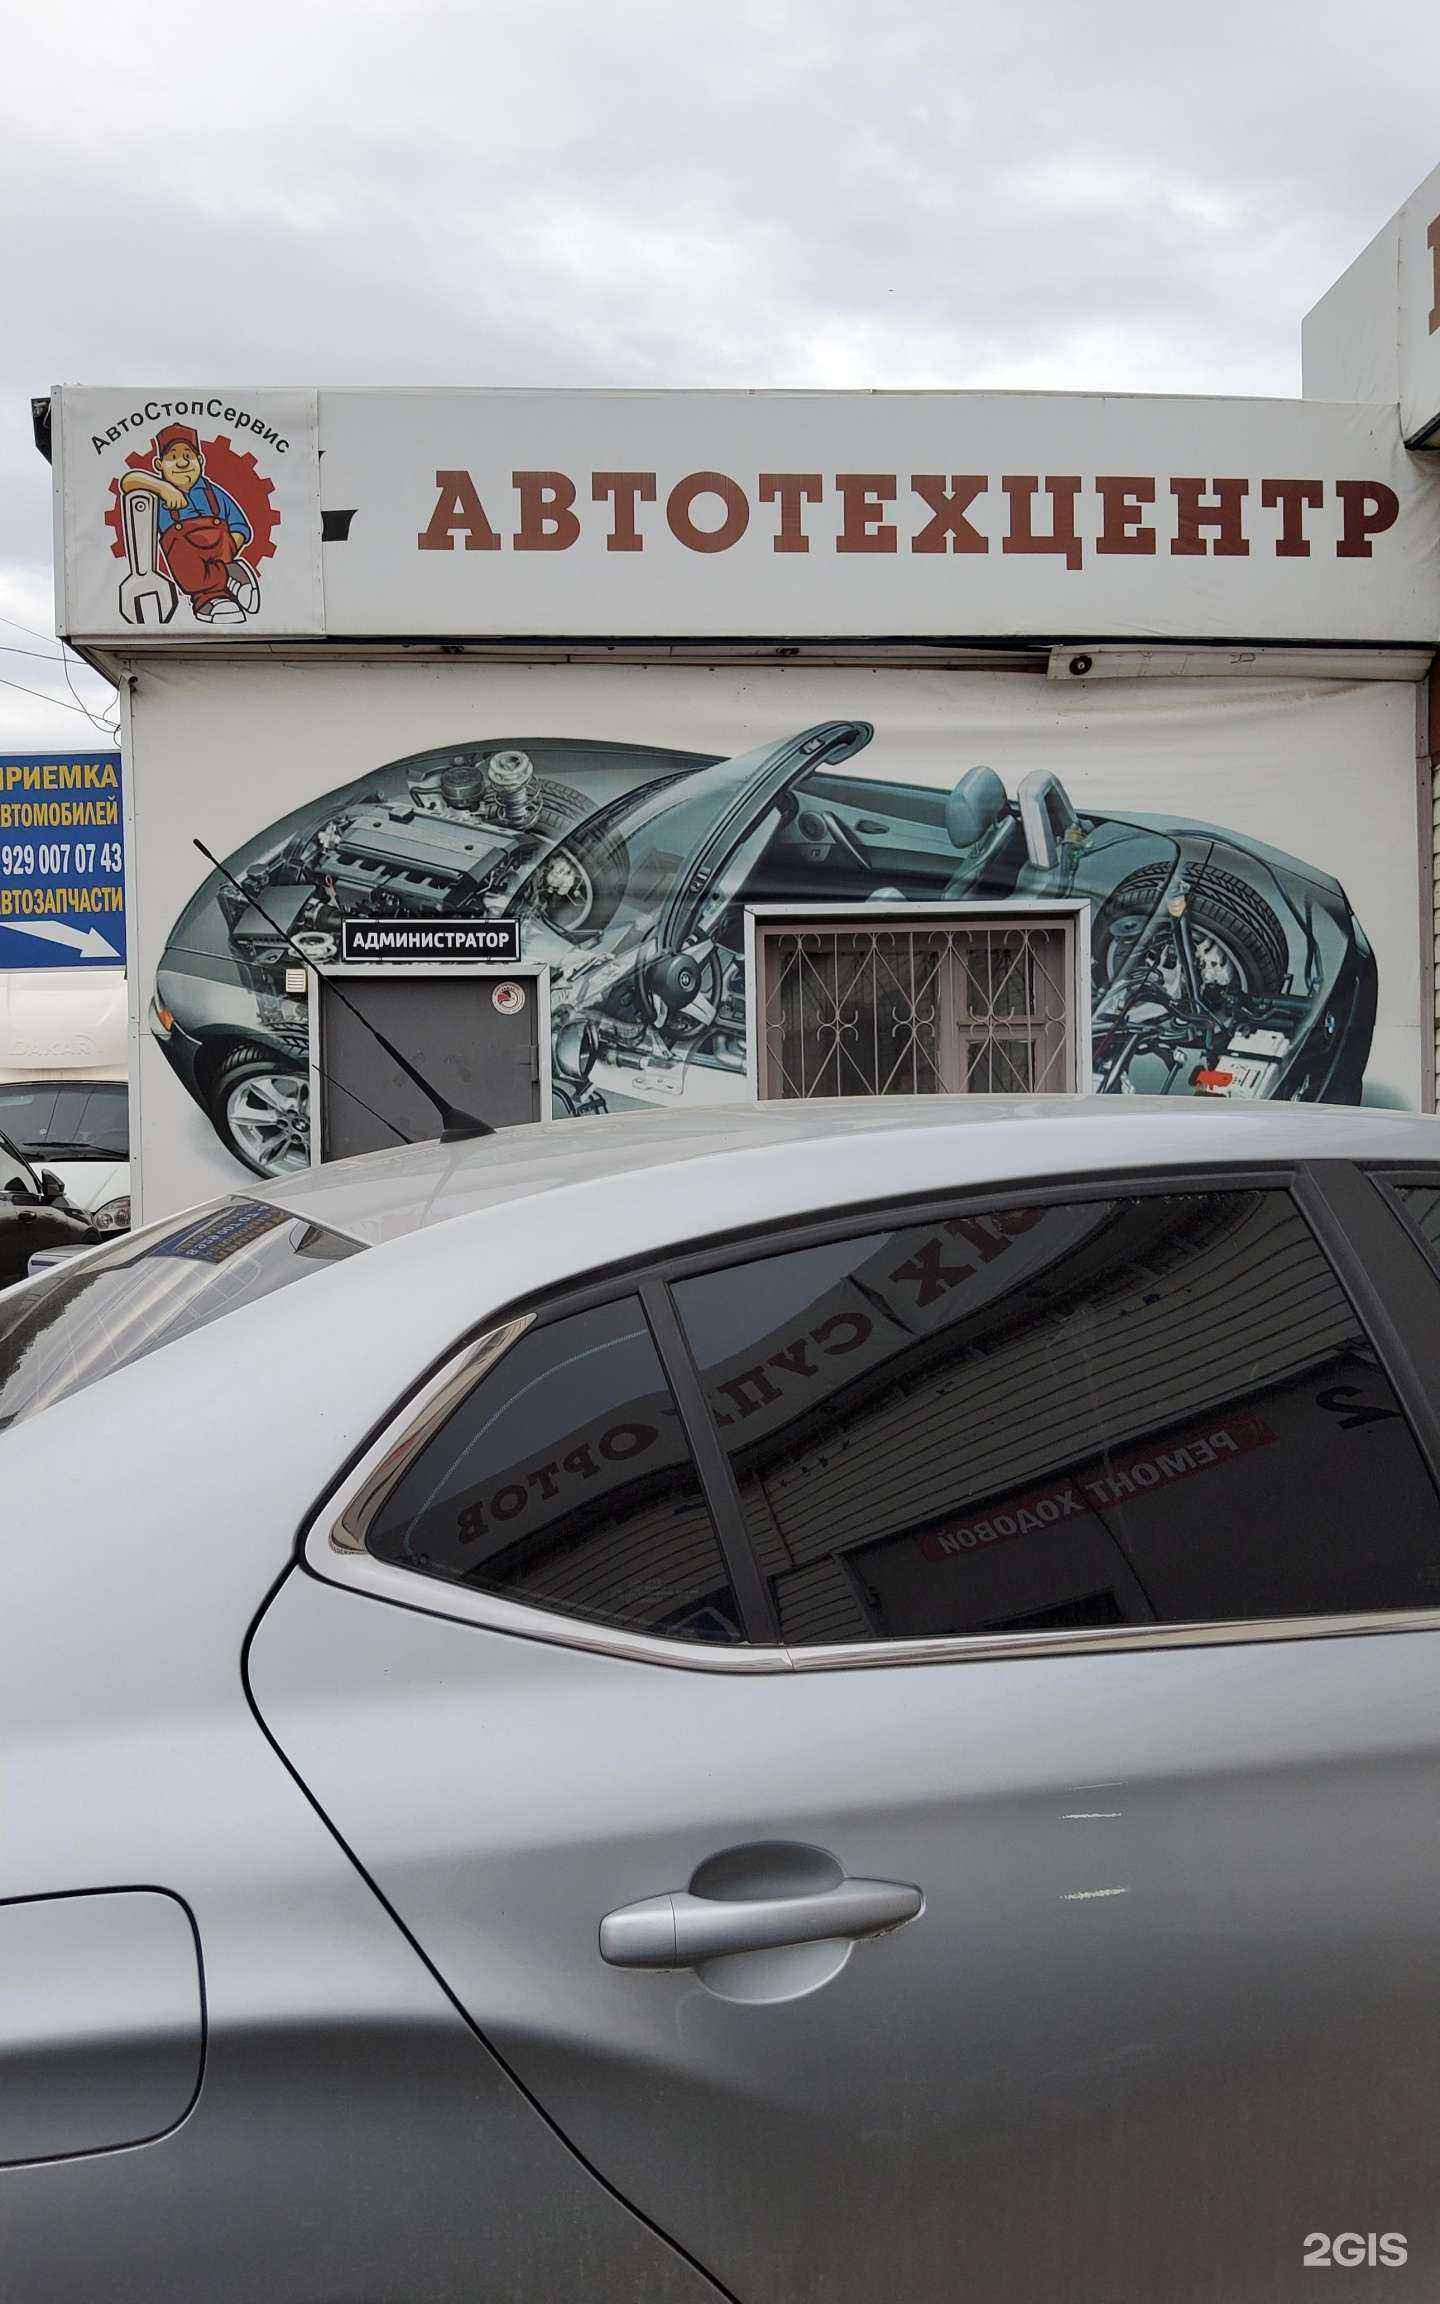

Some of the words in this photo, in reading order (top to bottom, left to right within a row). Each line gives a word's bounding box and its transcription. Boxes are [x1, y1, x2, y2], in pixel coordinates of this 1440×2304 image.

[91, 398, 290, 455] АвтоСтопСервис
[417, 470, 1400, 570] АВТОТЕХЦЕНТР
[0, 764, 119, 791] РИЕМКА
[0, 795, 118, 828] ВТОМОБИЛЕЙ
[2, 845, 34, 875] 929
[39, 844, 70, 874] 007
[75, 843, 96, 873] 07
[101, 842, 122, 872] 43
[0, 886, 123, 915] ВТОЗАПЧАСТИ
[353, 932, 510, 949] АДМИНИСТРАТОР
